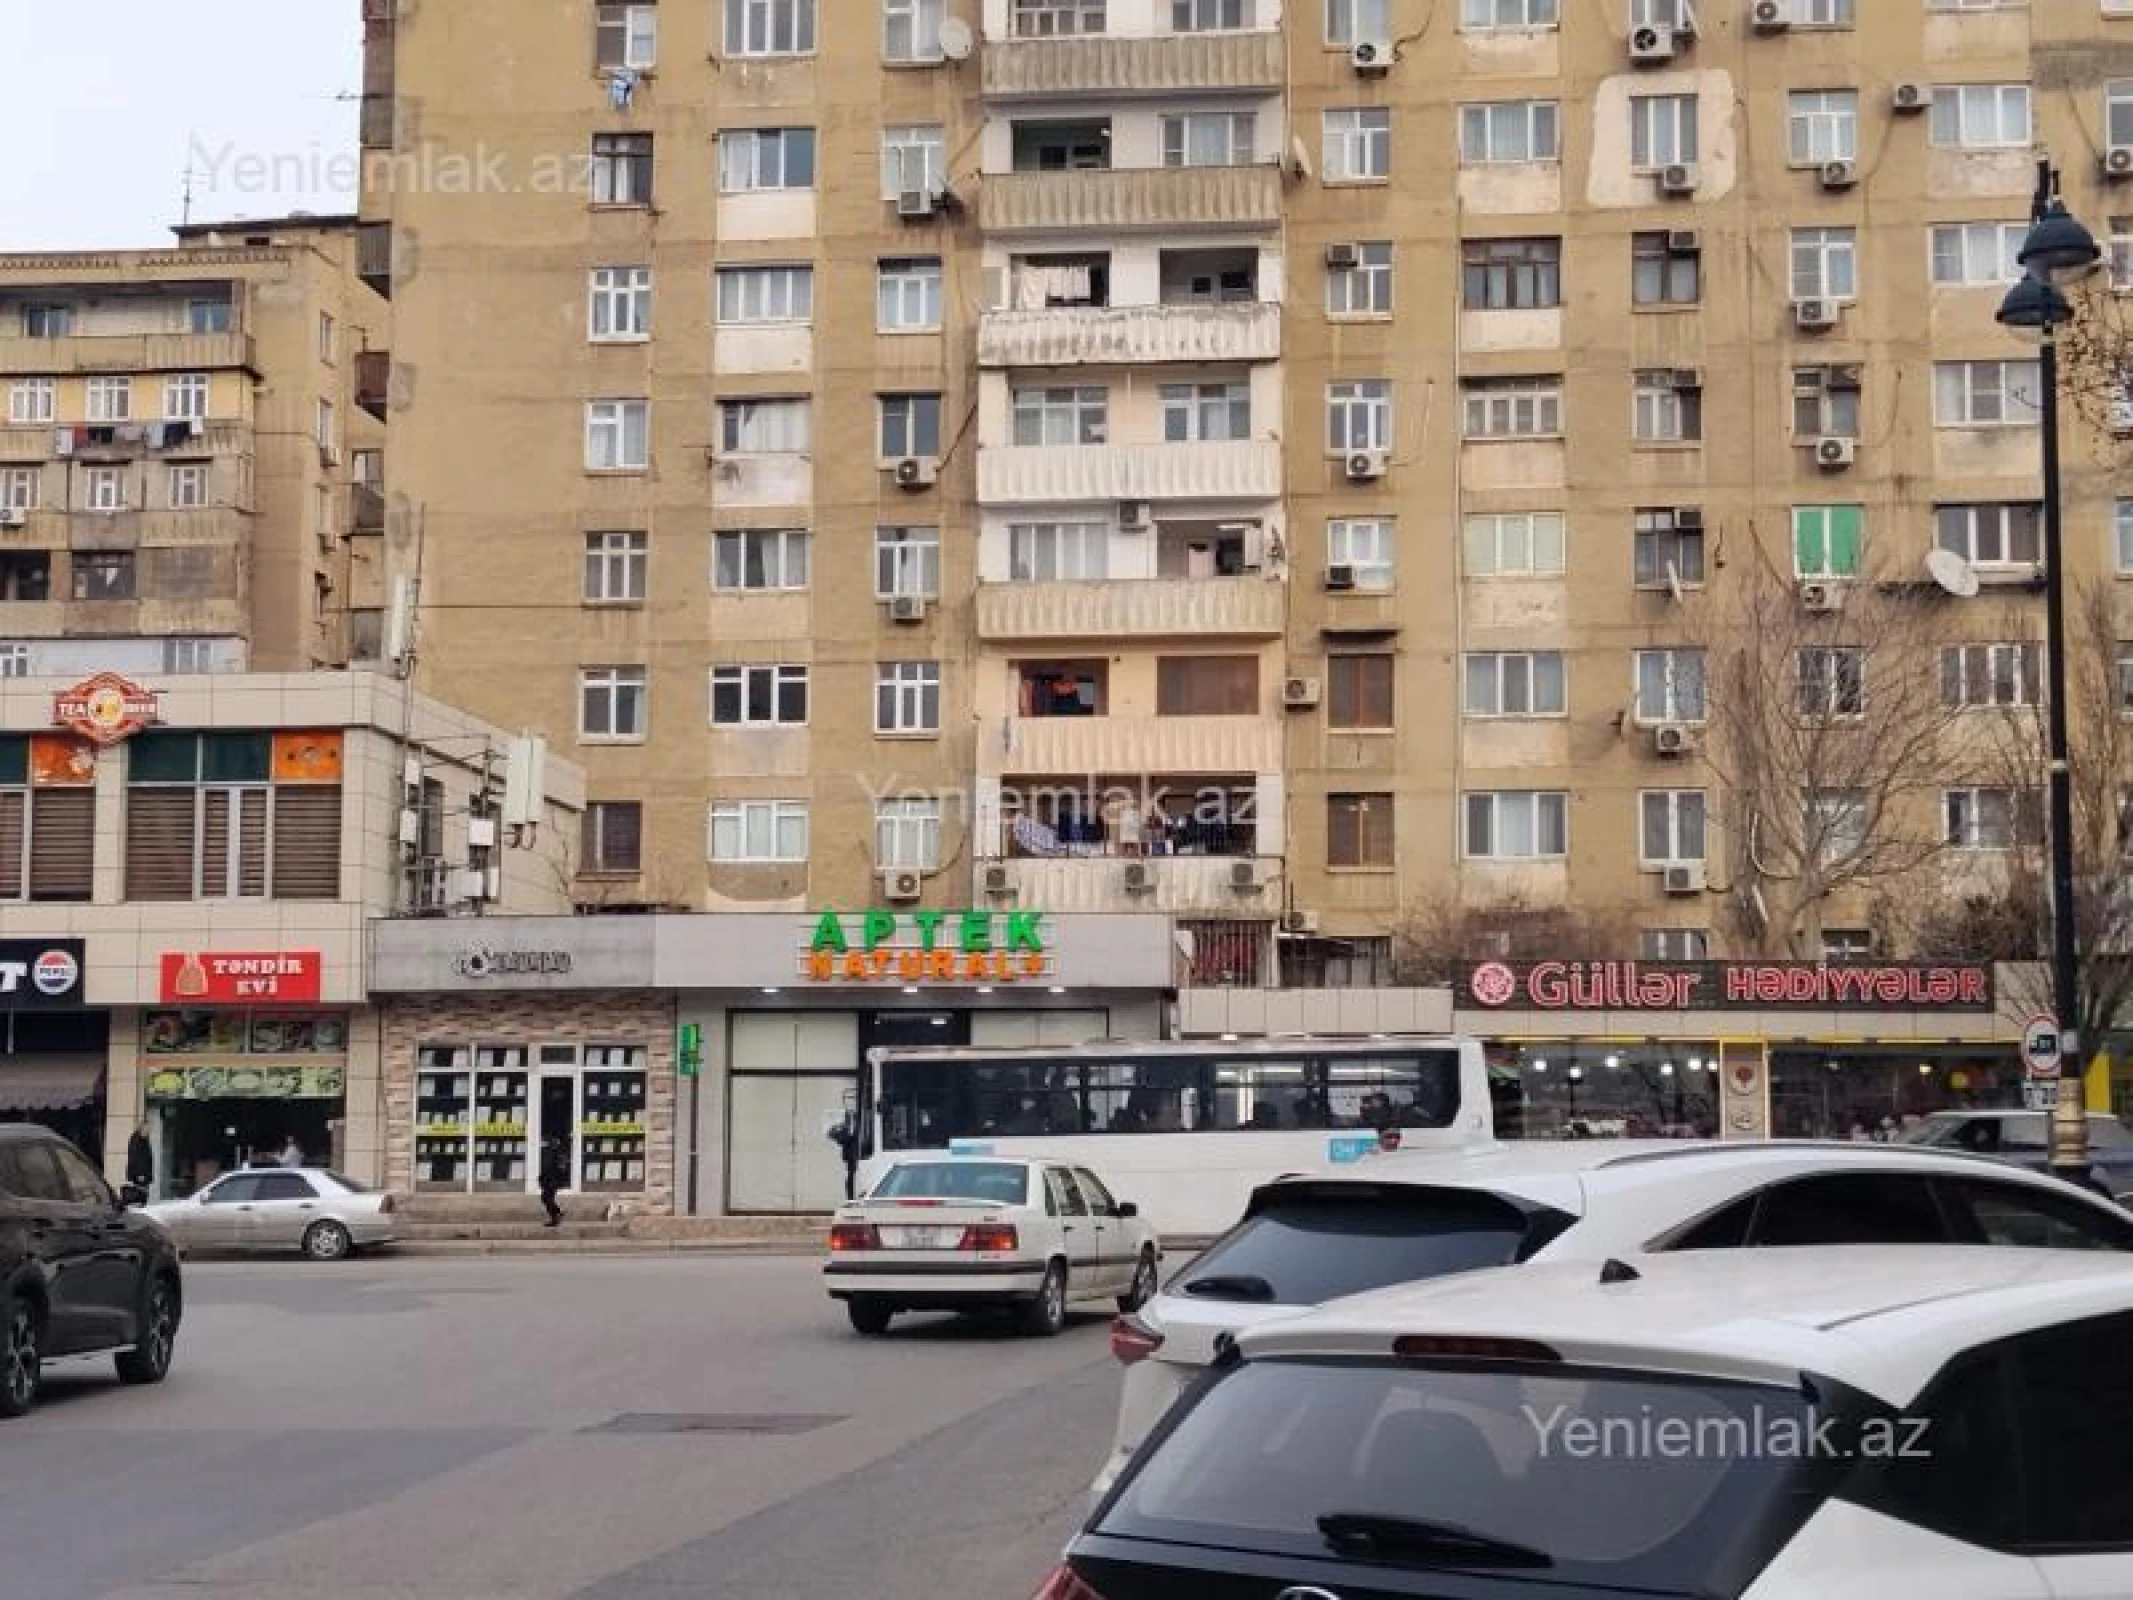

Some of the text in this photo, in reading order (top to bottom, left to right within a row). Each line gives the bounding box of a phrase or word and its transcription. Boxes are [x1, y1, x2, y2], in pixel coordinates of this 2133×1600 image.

[811, 908, 1042, 951] APTEK
[1528, 962, 1987, 1008] Güllər HƏDİYYƏLƏR
